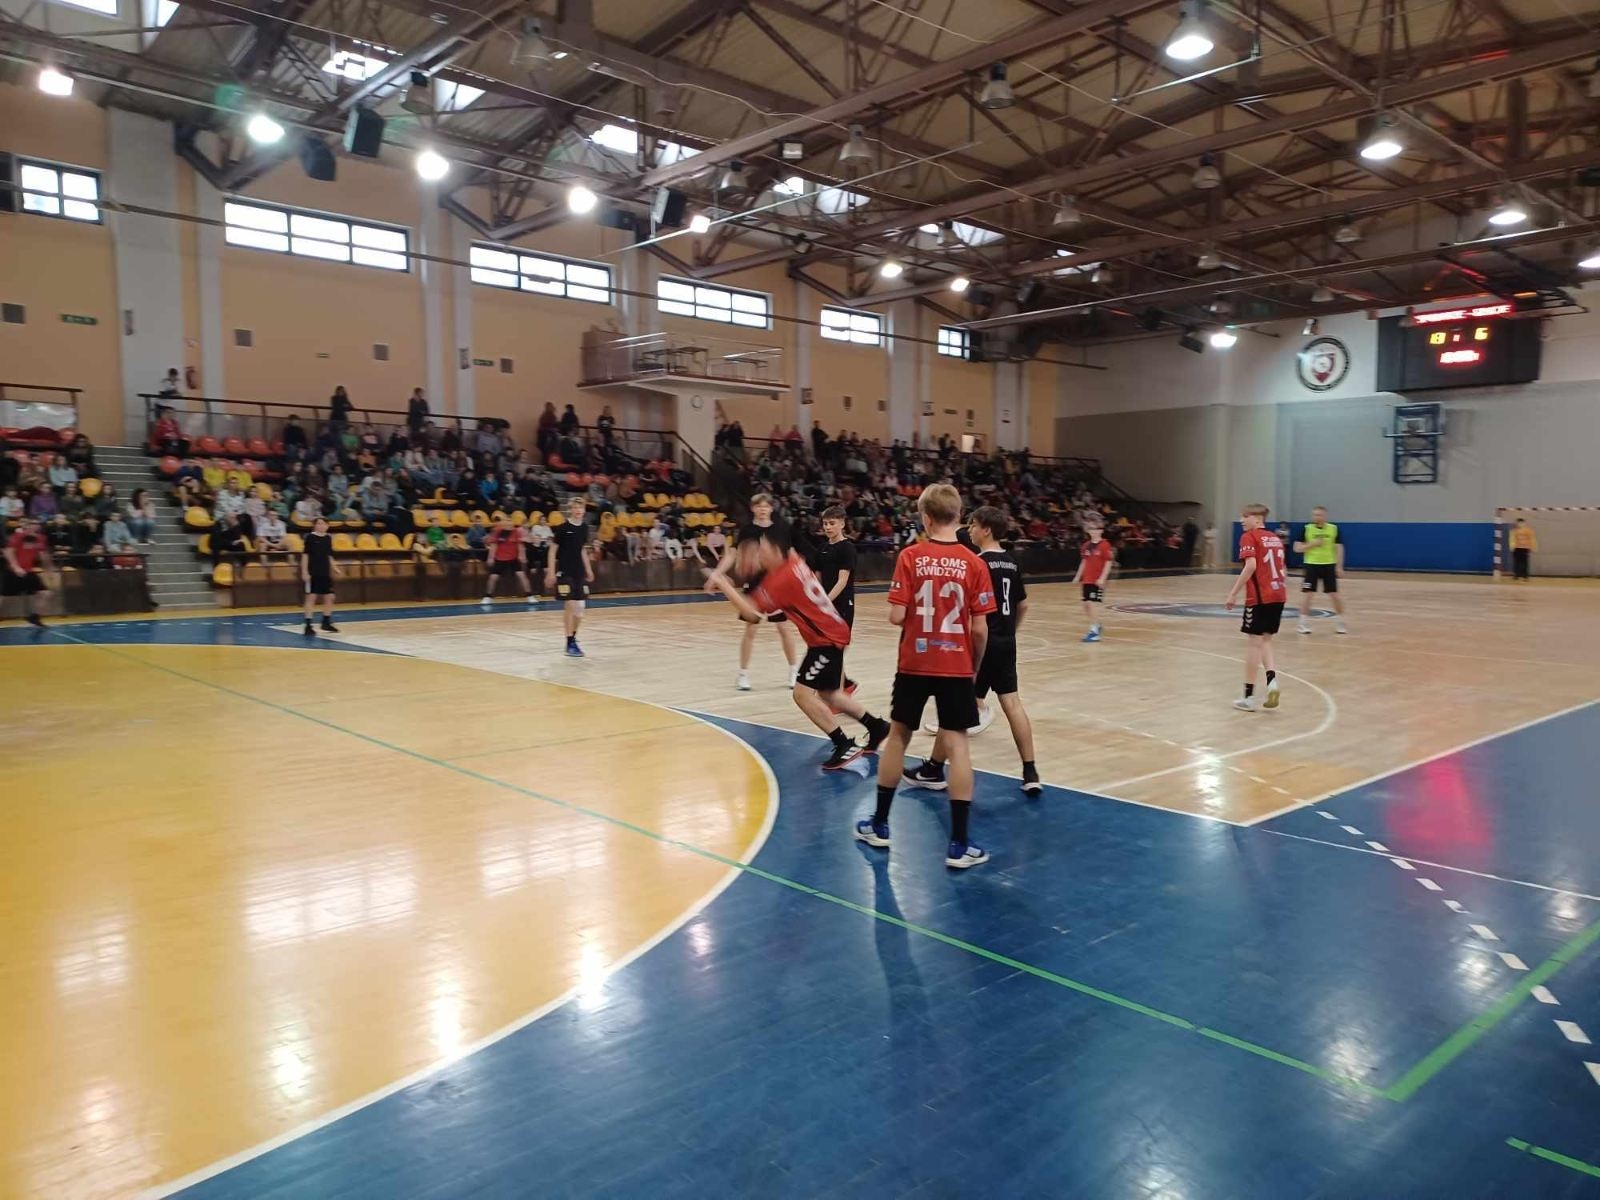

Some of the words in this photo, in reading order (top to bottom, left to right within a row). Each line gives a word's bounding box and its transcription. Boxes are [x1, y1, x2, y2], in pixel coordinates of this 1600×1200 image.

[915, 556, 930, 567] SP
[940, 557, 967, 570] OMS
[916, 566, 966, 579] KWIDZYN
[1002, 577, 1011, 615] 9
